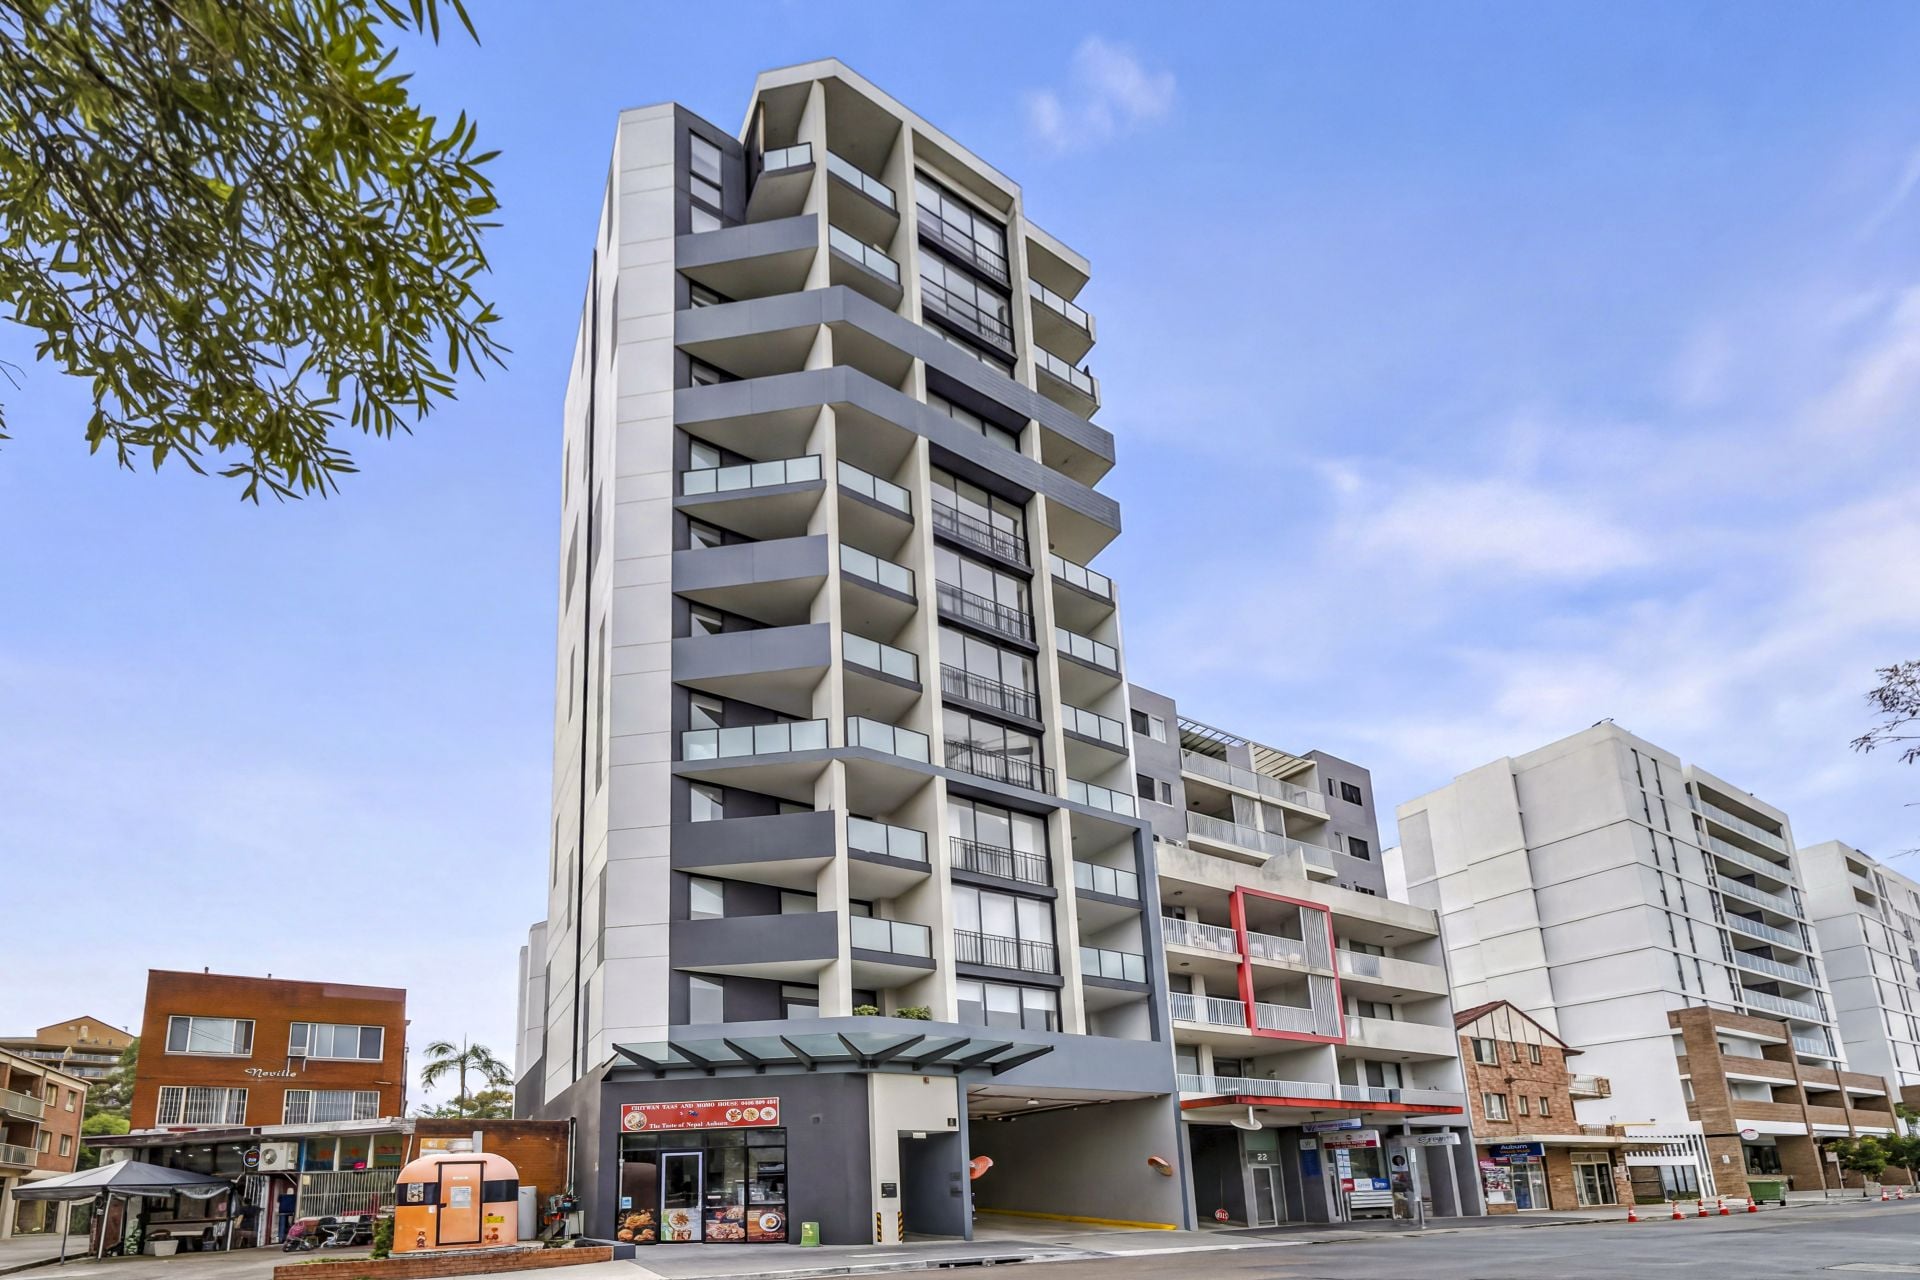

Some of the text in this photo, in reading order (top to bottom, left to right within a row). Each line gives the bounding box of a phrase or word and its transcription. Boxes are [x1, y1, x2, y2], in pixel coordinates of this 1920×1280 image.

[244, 1068, 297, 1077] Neville
[686, 1121, 703, 1129] Nepal
[1257, 1153, 1268, 1161] 22
